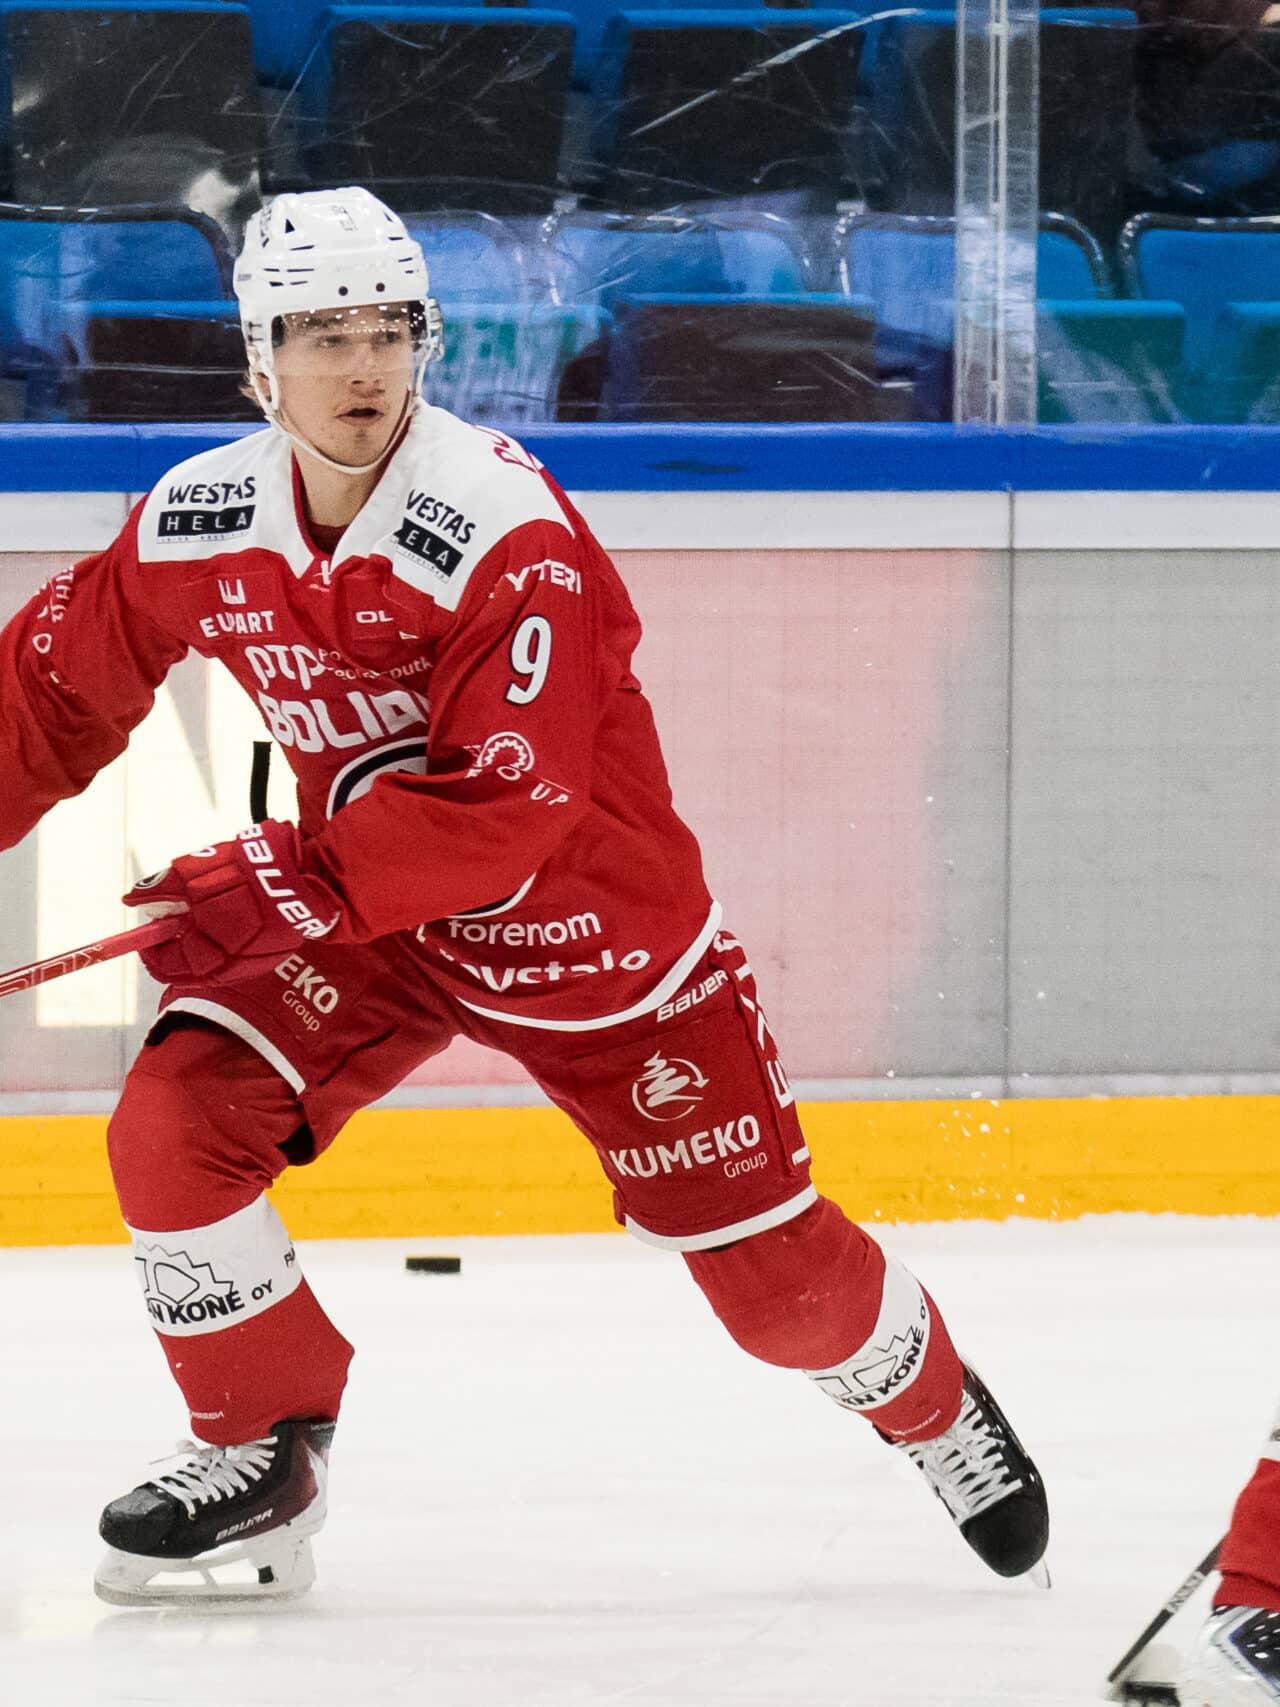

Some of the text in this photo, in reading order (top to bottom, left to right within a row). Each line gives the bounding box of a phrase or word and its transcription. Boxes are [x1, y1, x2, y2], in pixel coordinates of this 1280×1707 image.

[167, 476, 256, 505] WESTAS
[166, 512, 247, 531] HELA
[392, 529, 449, 566] ELA
[488, 559, 581, 598] YTERI
[505, 614, 552, 705] 9
[256, 688, 430, 753] BOLID
[282, 990, 321, 1033] Group
[609, 1114, 761, 1178] KUMEKO
[723, 1151, 768, 1178] Group
[251, 1279, 274, 1301] OY
